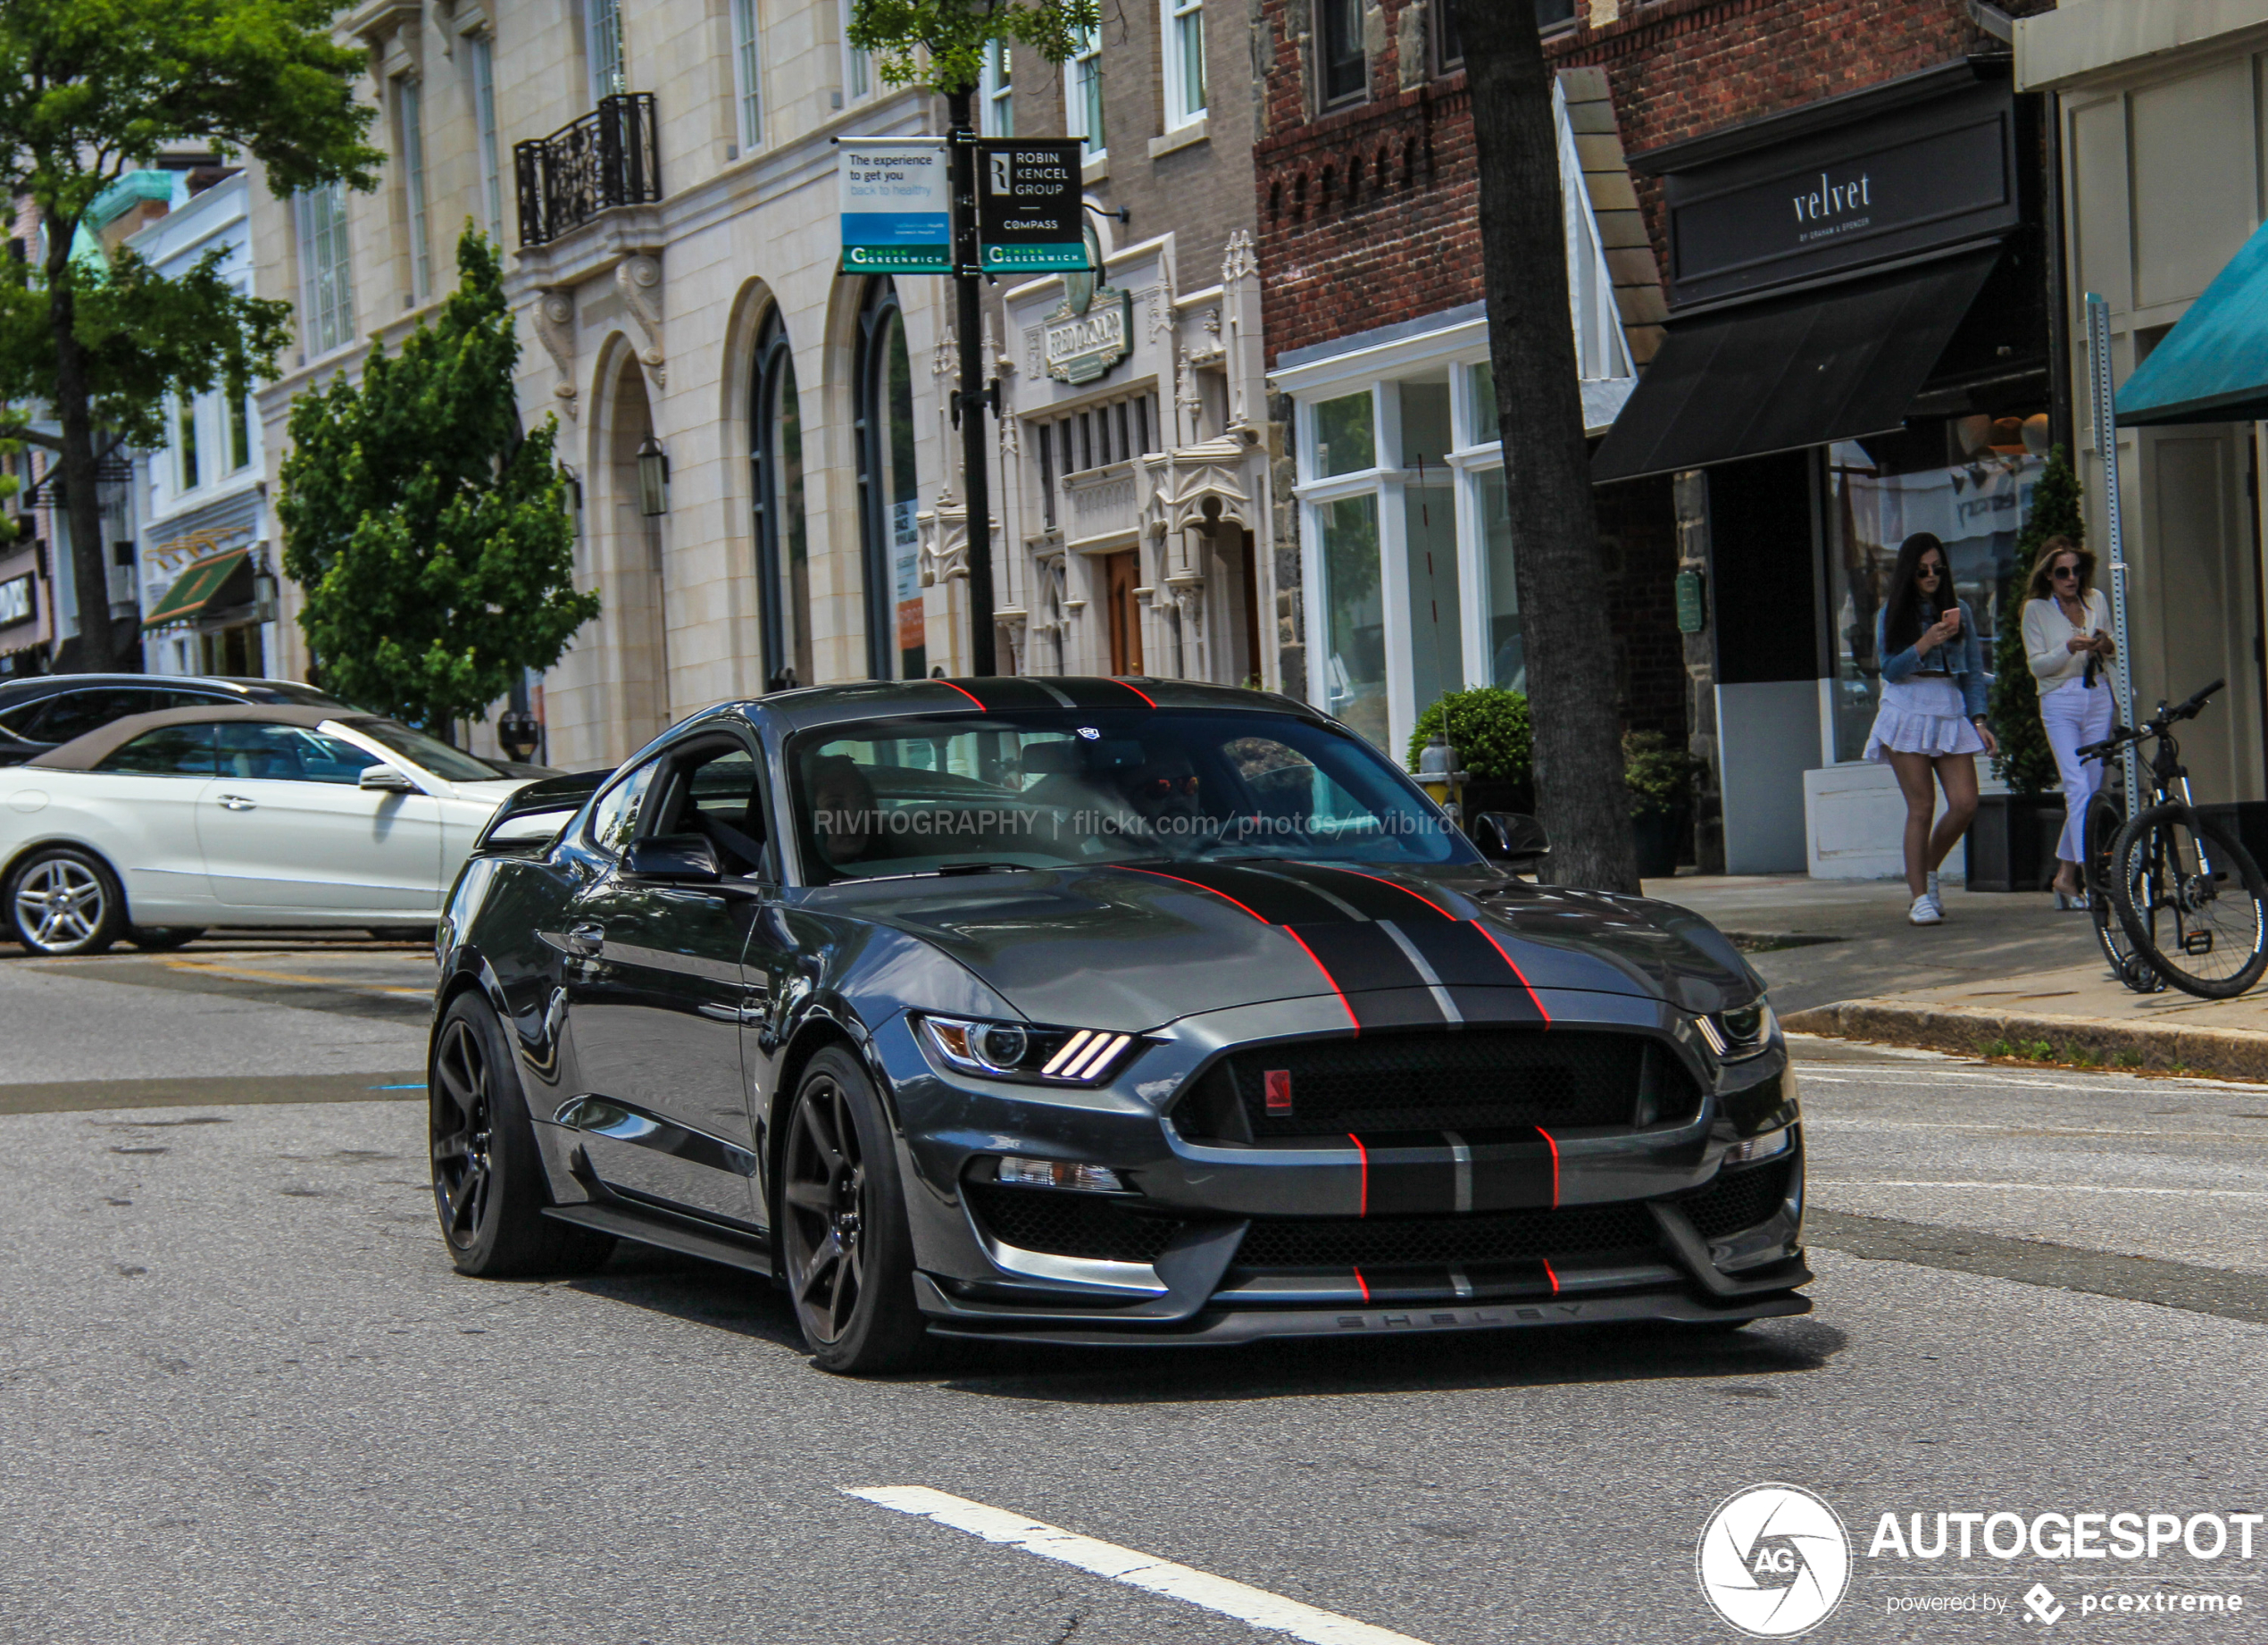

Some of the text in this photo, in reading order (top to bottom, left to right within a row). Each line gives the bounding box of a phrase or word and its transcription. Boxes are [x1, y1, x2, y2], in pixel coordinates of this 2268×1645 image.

[849, 154, 933, 167] The experience
[1016, 152, 1060, 163] ROBIN
[850, 170, 904, 182] to get you
[1016, 168, 1069, 180] KENCEL
[851, 184, 931, 196] back to healthy
[1015, 184, 1063, 195] GROUP
[1793, 172, 1871, 222] velvet
[1004, 220, 1058, 230] COMPASS
[1843, 217, 1869, 230] SPENCER
[1005, 255, 1079, 263] GREENWICH
[1337, 1306, 1581, 1329] SHELBY
